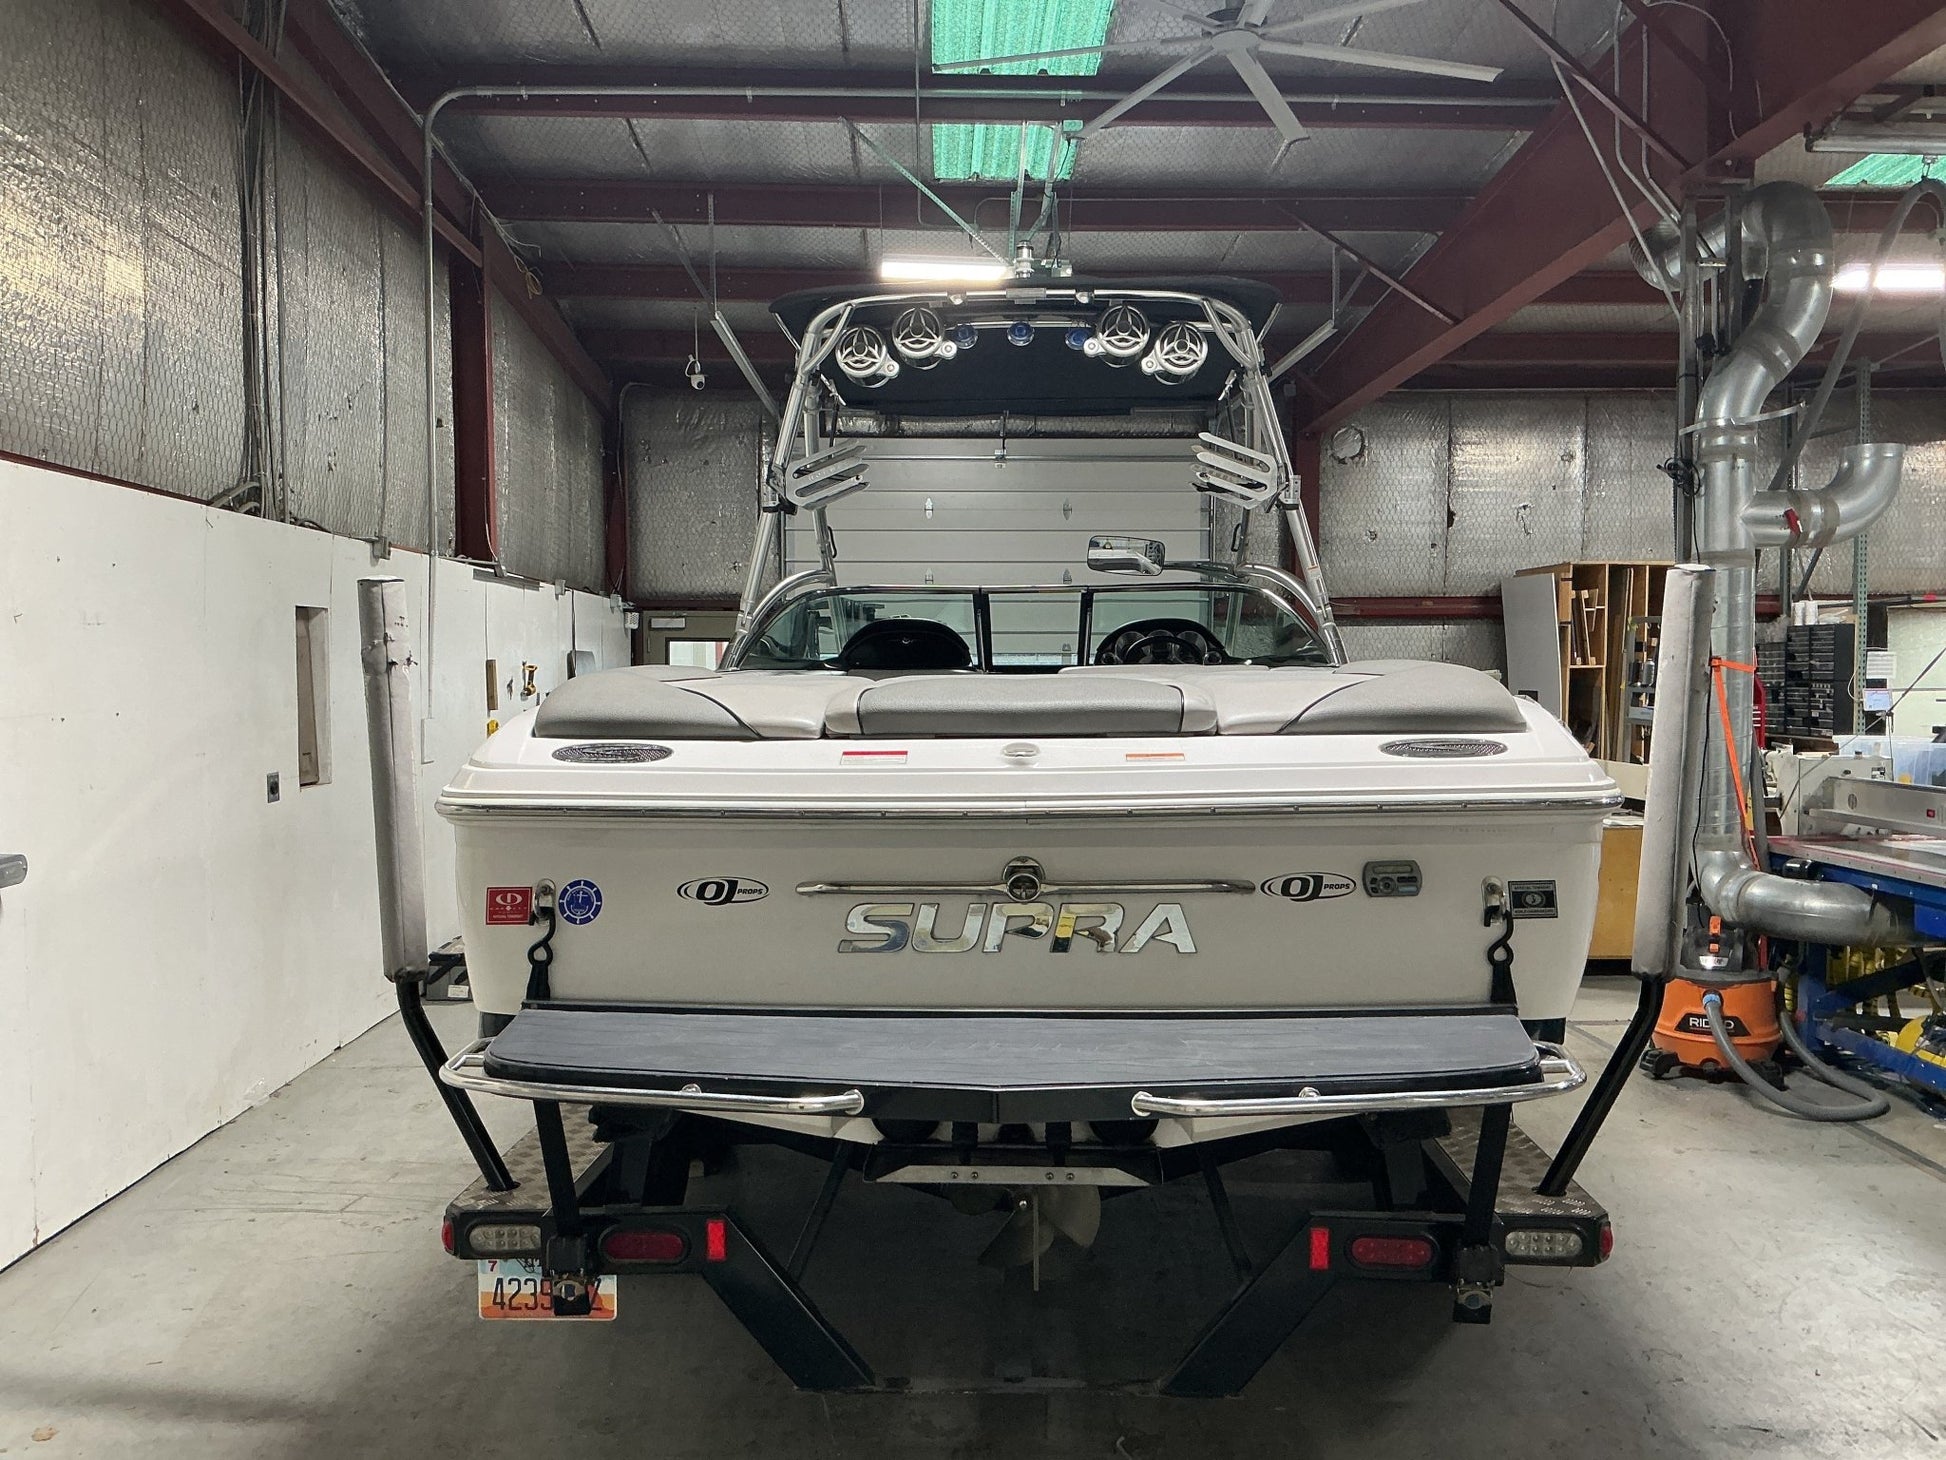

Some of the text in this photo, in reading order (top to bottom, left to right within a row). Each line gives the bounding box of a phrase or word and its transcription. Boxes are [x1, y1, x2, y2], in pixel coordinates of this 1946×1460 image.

[695, 879, 739, 906] OJ
[1280, 875, 1324, 902] OJ
[838, 902, 1198, 953] SUPRA
[1689, 1017, 1735, 1029] RIDD
[487, 1260, 498, 1272] 7
[492, 1277, 602, 1311] 4239Z
